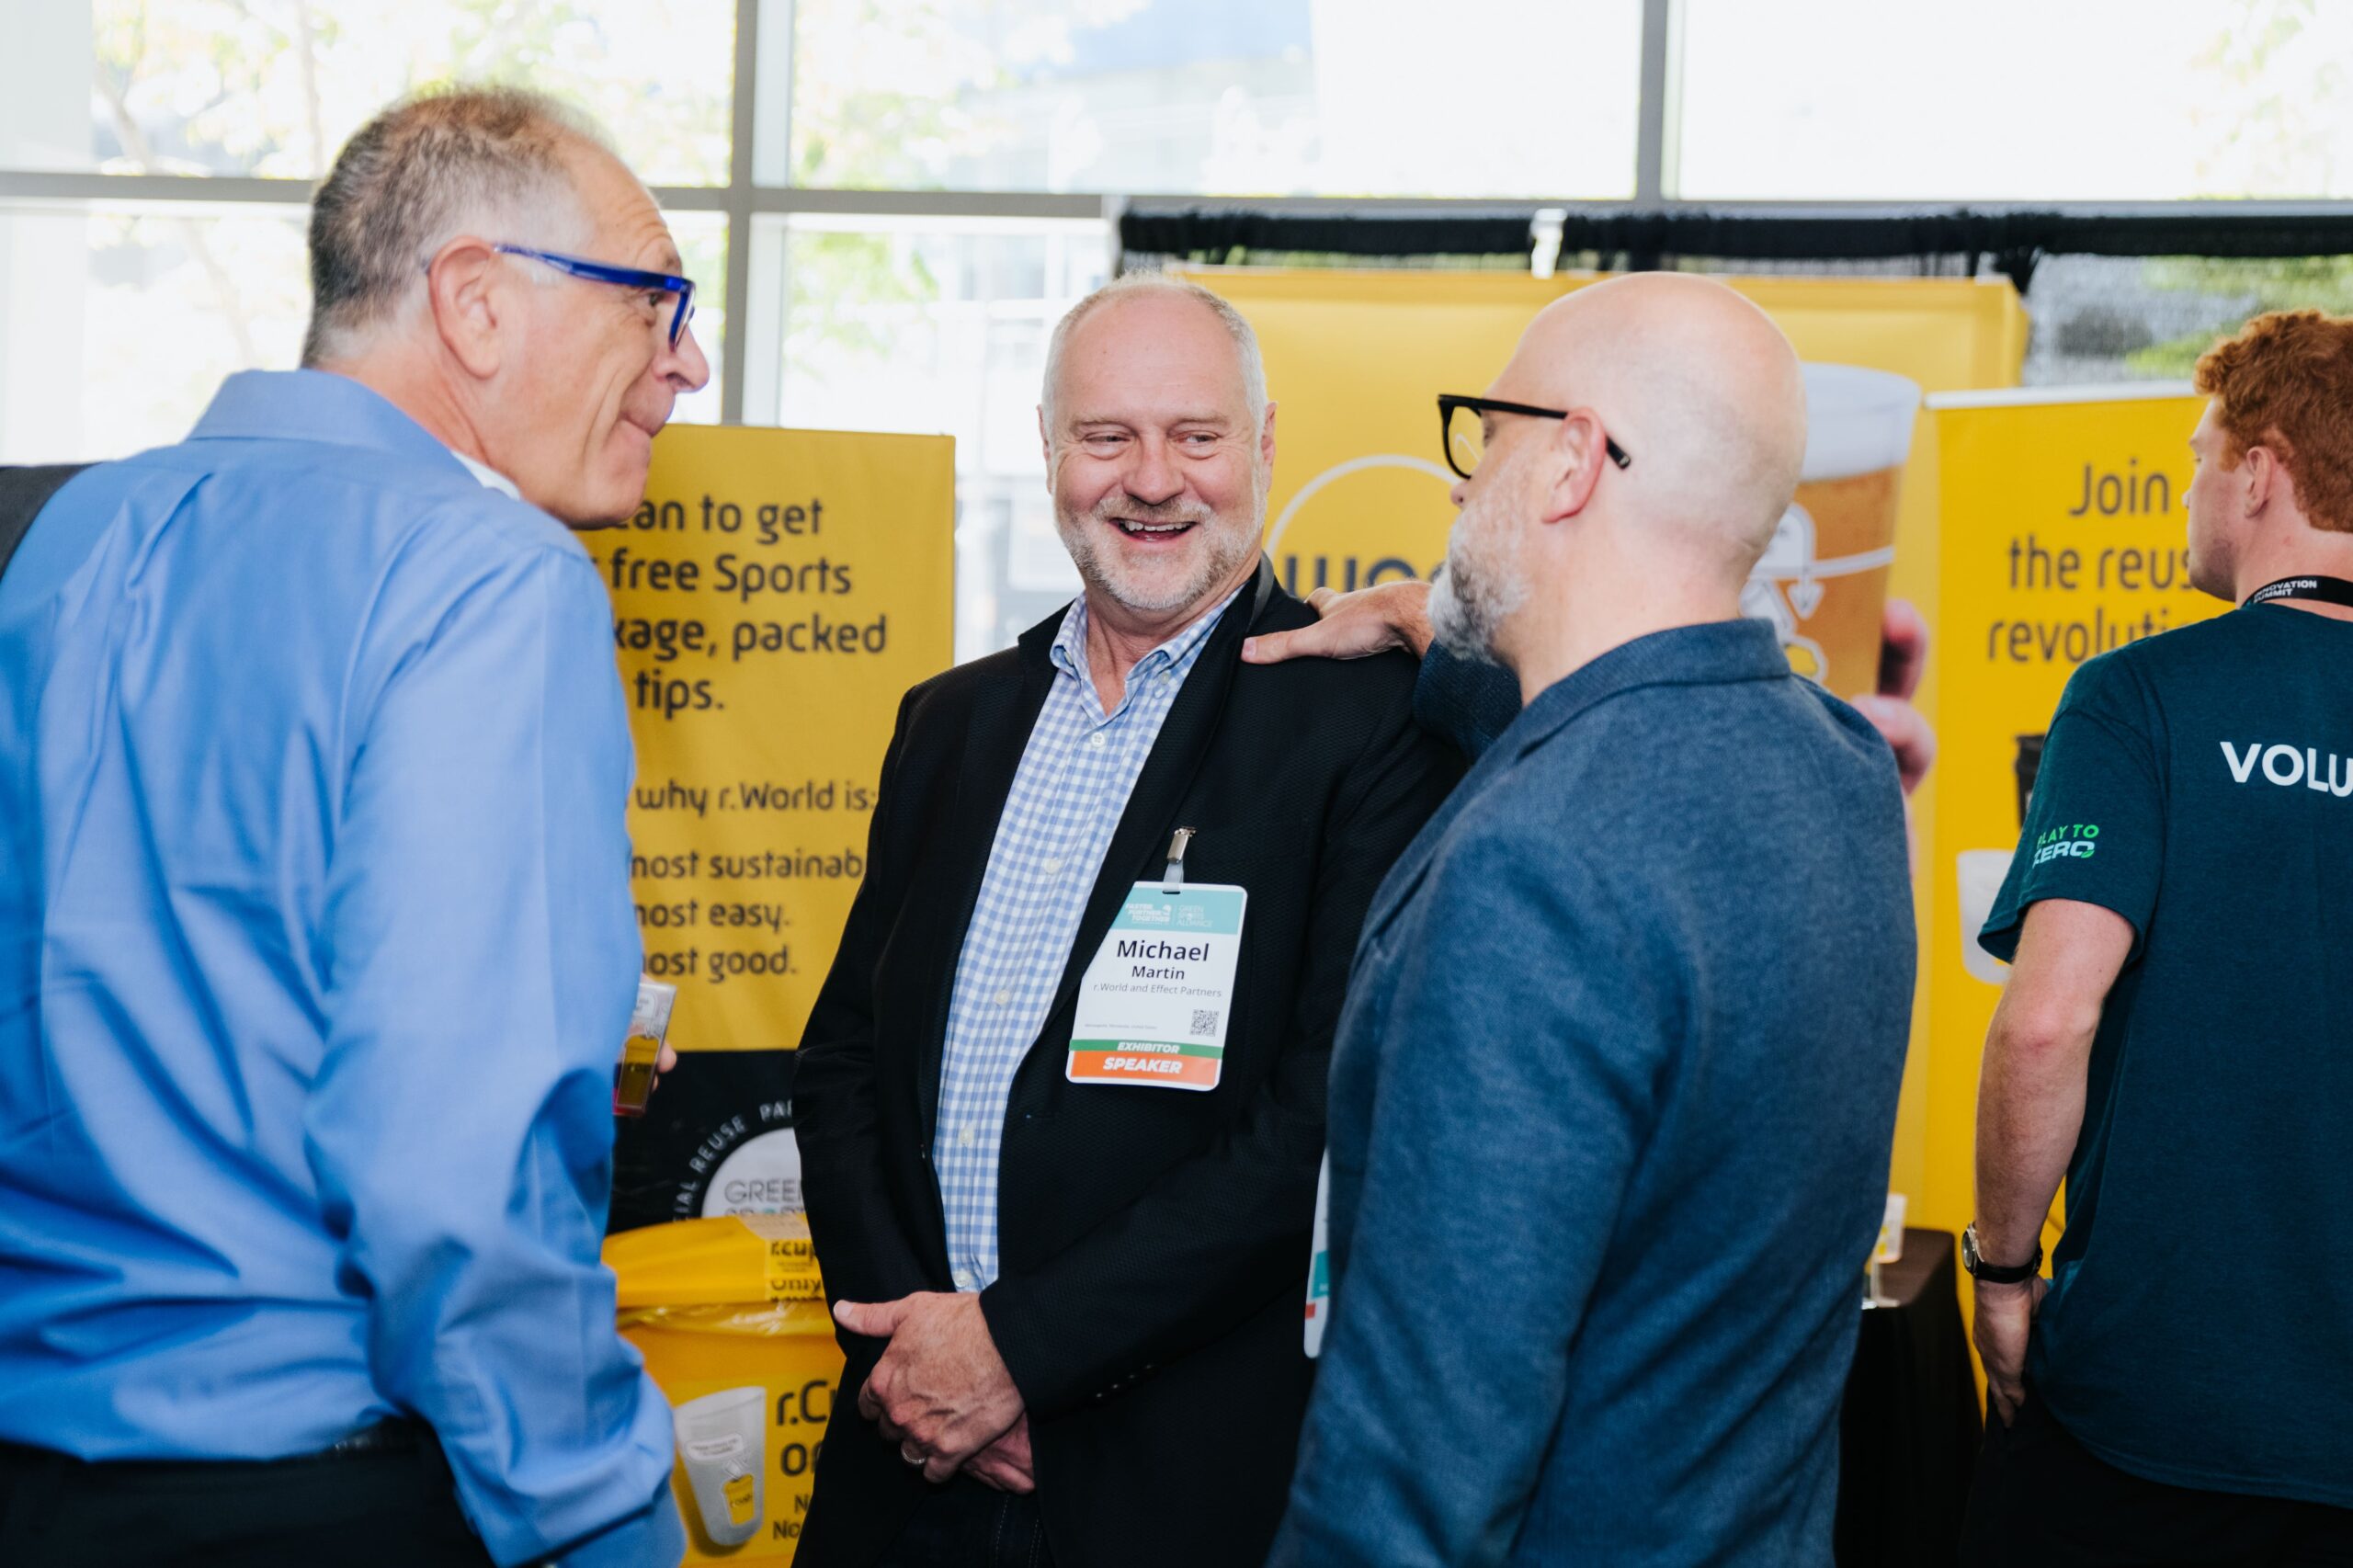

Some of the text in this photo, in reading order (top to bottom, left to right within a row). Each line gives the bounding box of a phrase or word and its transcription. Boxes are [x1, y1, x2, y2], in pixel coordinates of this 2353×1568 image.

[2069, 458, 2170, 517] Join
[617, 494, 824, 545] an to get
[611, 547, 852, 603] free Sports
[2010, 534, 2081, 591] the
[732, 612, 887, 662] packed
[633, 668, 725, 720] tips.
[2220, 741, 2353, 798] VOLU
[635, 779, 708, 819] why
[718, 779, 834, 811] r.World
[2074, 824, 2099, 838] TO
[709, 846, 862, 879] sustainab
[708, 902, 790, 934] easy.
[642, 944, 798, 983] ost good.
[1117, 939, 1210, 961] Michael
[1093, 983, 1222, 998] r.World and Effect Partners
[1131, 965, 1186, 981] Martin
[1103, 1057, 1184, 1074] SPEAKER
[1117, 1041, 1181, 1054] EXHIBITOR
[689, 1114, 747, 1174] REUSE
[724, 1178, 802, 1205] GREE
